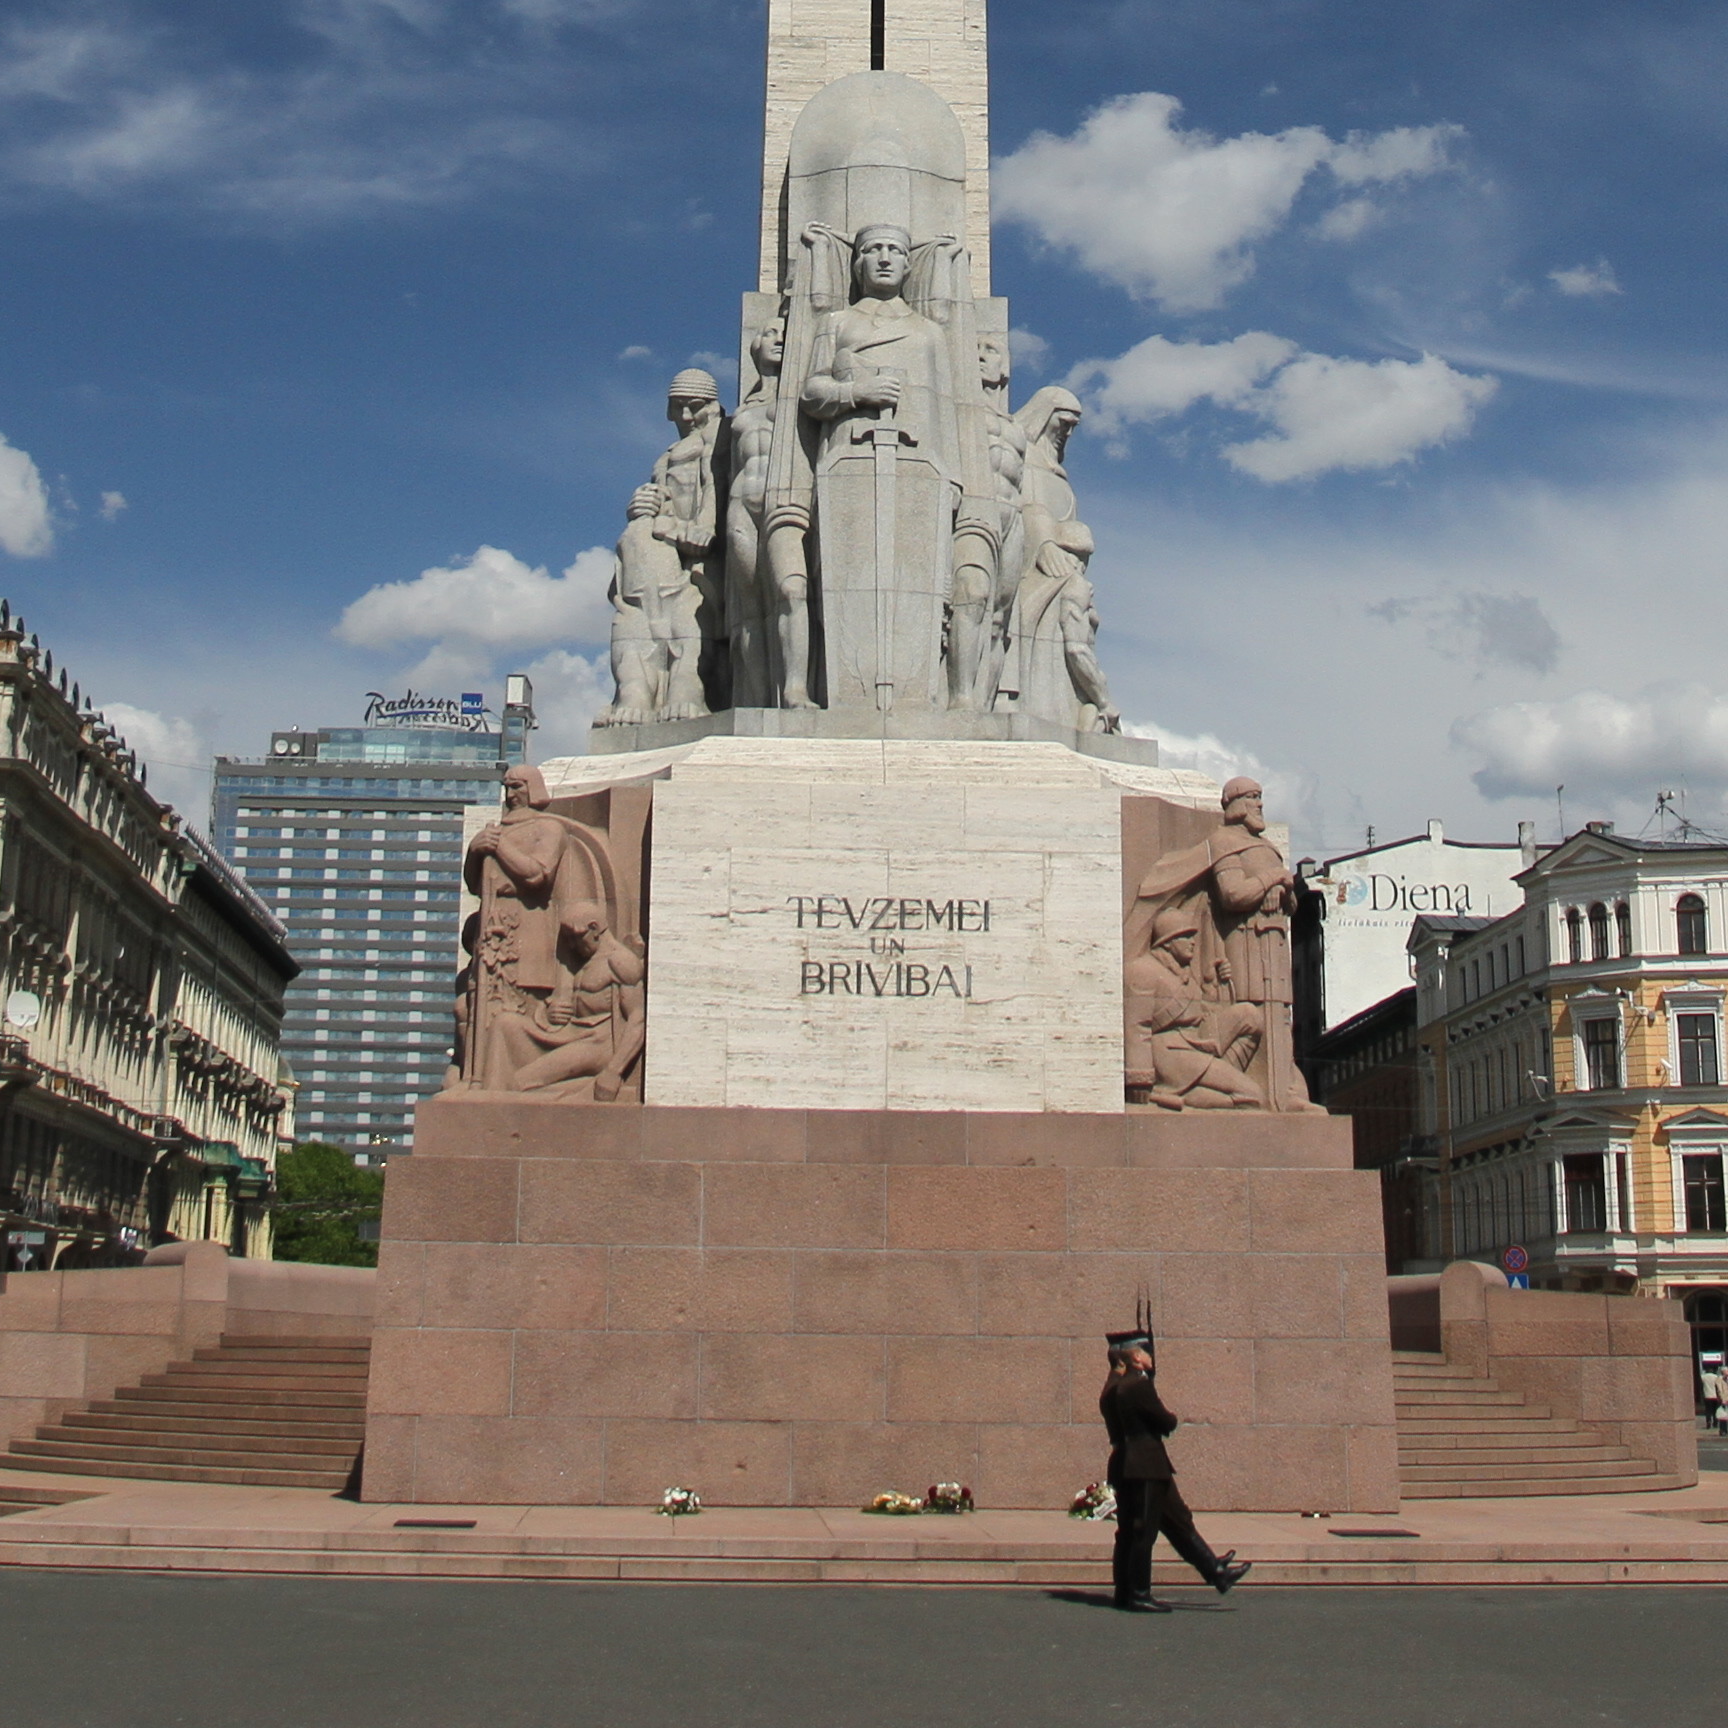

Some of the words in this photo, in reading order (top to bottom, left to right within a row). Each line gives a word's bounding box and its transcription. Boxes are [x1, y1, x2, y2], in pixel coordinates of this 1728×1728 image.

[364, 688, 459, 722] Radisson
[462, 700, 482, 709] BLU
[1369, 873, 1473, 912] Diena
[786, 893, 991, 932] TĒVZEMEI
[870, 936, 905, 956] UN
